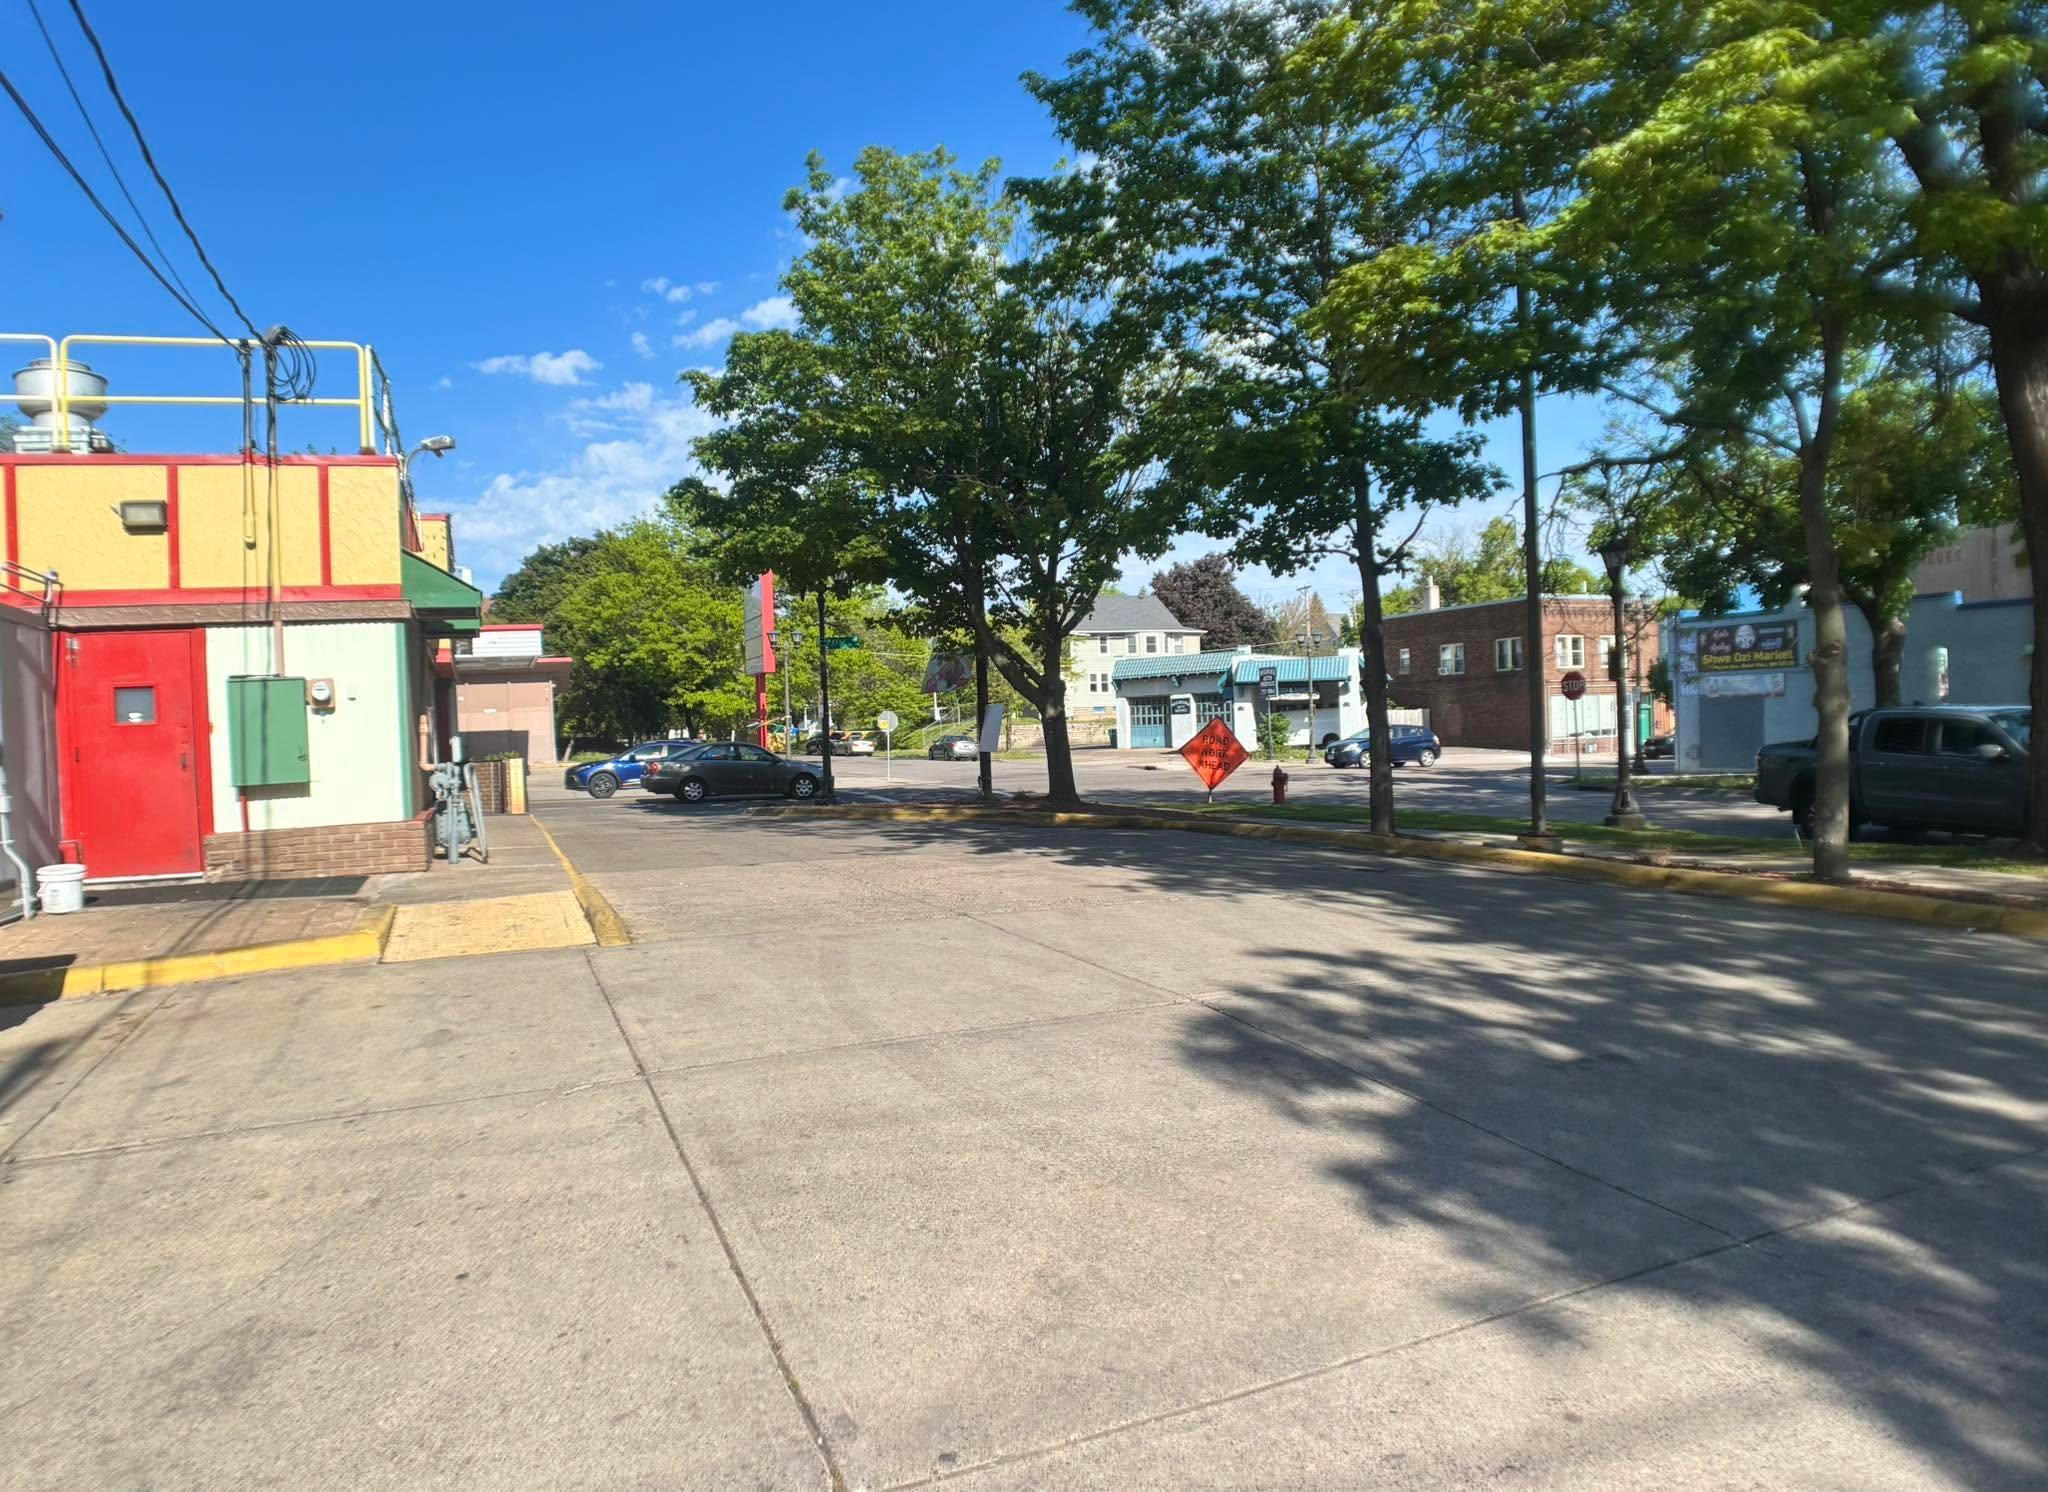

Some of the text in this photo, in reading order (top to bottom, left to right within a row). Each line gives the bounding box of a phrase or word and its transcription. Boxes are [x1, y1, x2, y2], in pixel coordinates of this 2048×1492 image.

[1753, 650, 1794, 661] Market
[1563, 680, 1585, 692] STOP
[1202, 735, 1230, 746] ROAD
[1201, 747, 1228, 758] WORK
[1198, 760, 1231, 771] AHEAD
